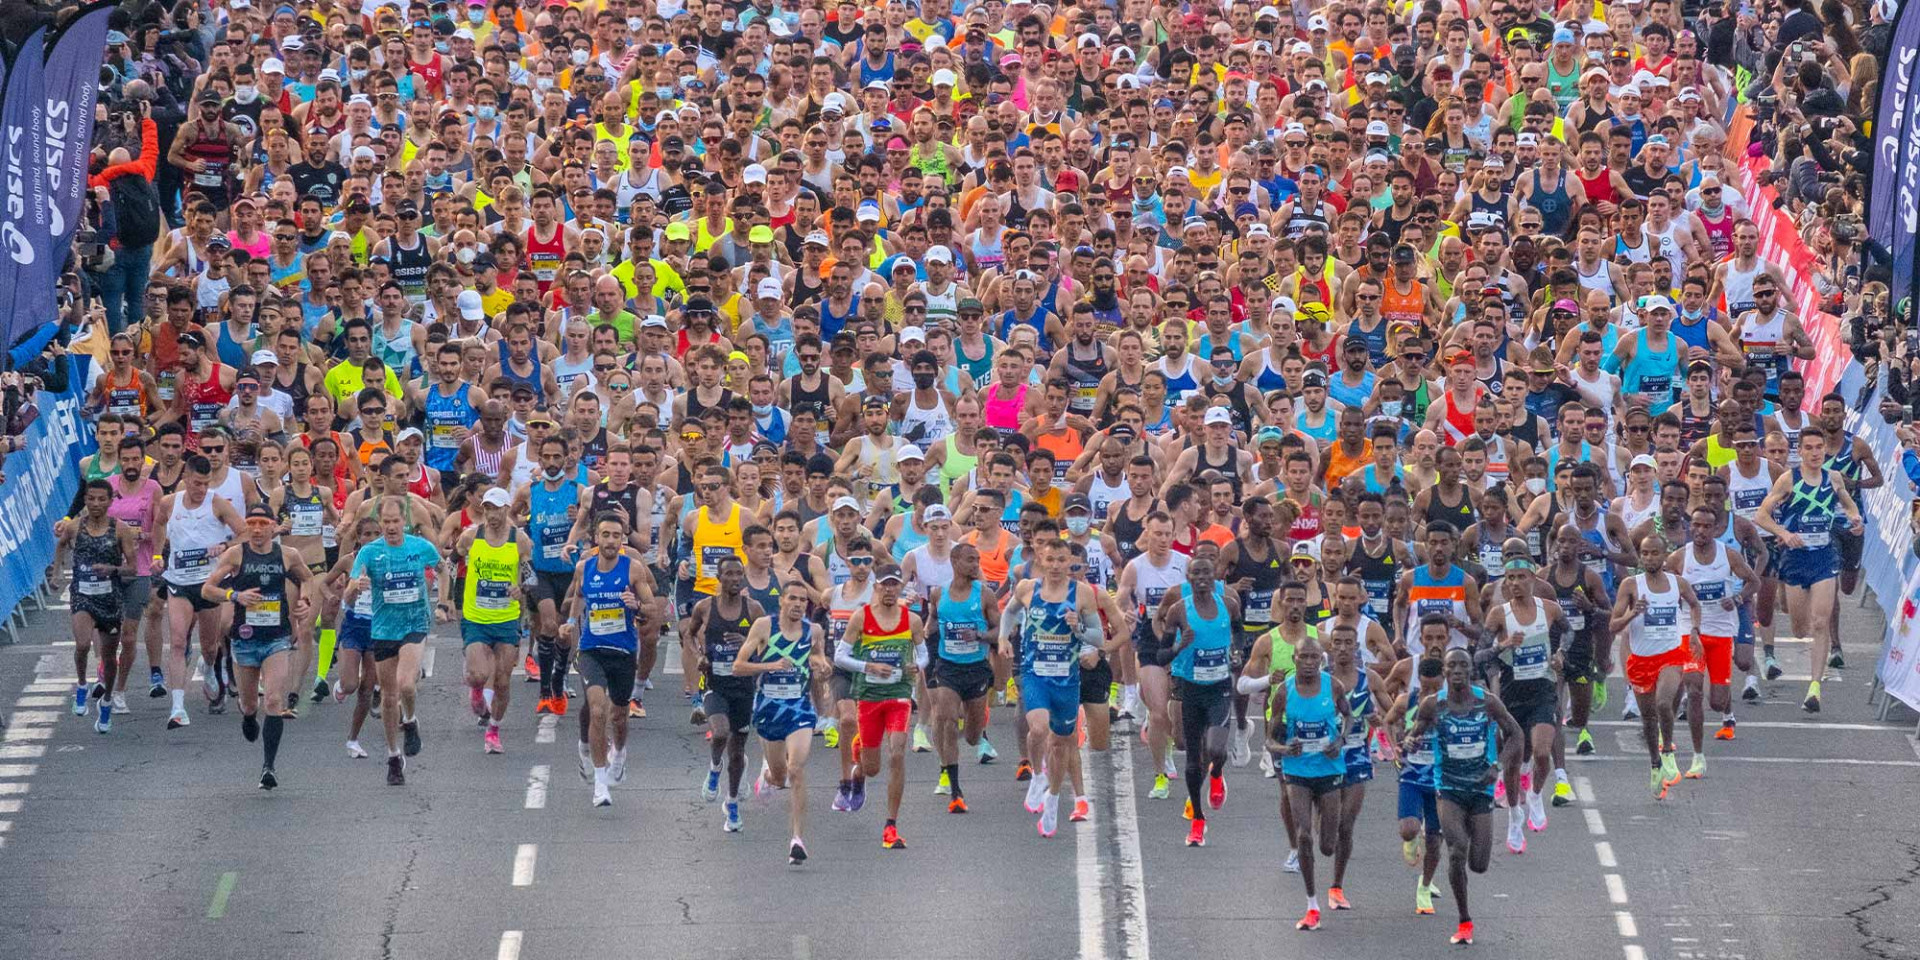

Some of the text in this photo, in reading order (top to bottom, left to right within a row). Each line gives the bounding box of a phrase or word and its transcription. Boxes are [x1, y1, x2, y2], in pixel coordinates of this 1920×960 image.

[71, 81, 93, 198] sound mind, sound body
[32, 106, 44, 224] sound mind, sound body
[245, 563, 283, 574] MARCIN
[393, 571, 414, 579] ZURICH
[953, 622, 975, 630] ZURICH
